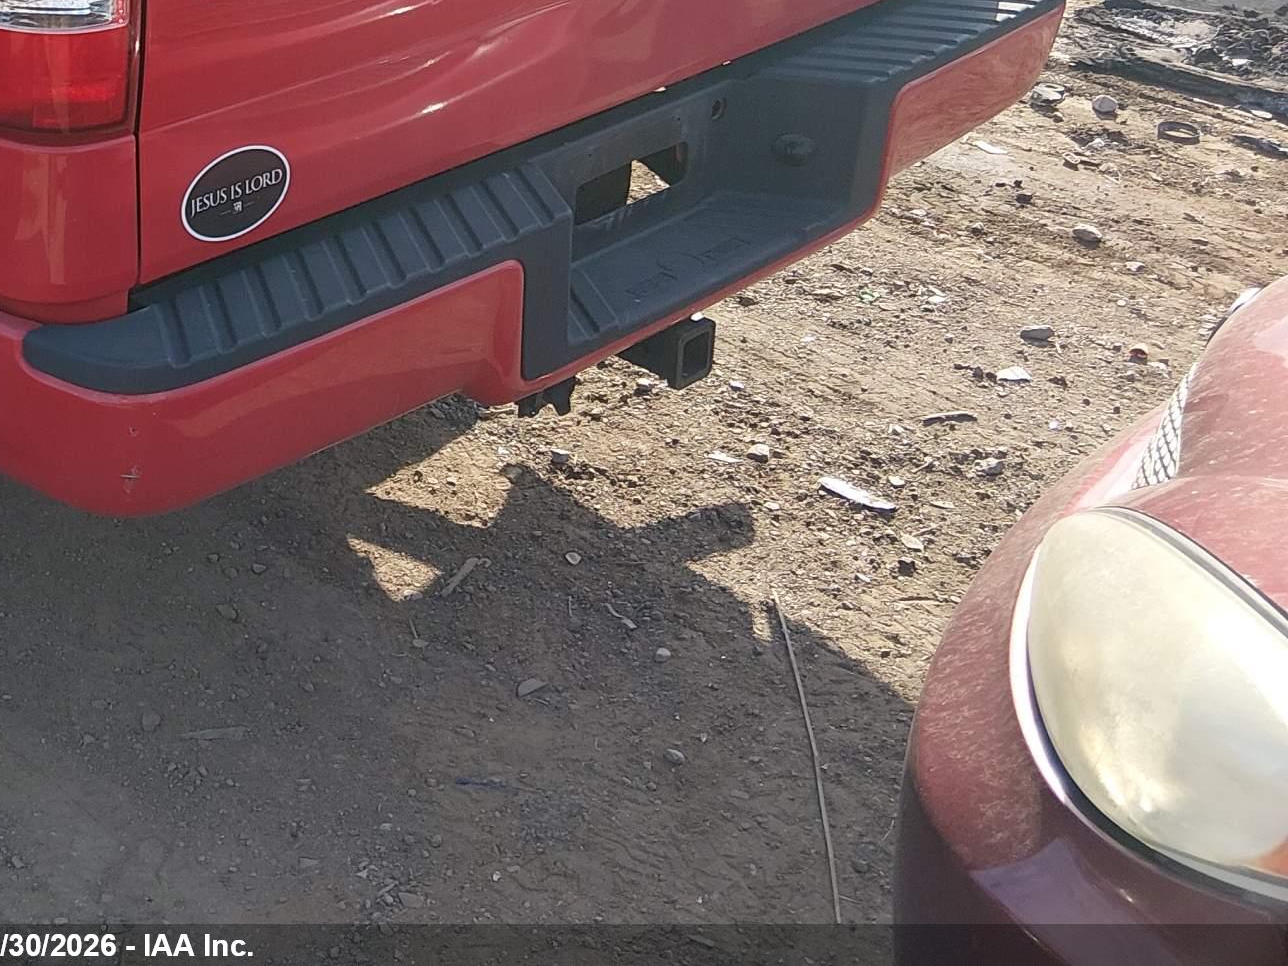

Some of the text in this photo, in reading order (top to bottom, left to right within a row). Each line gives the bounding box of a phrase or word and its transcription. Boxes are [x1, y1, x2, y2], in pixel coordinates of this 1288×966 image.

[191, 188, 228, 219] JESUS
[230, 182, 243, 200] IS
[245, 168, 283, 194] LORD
